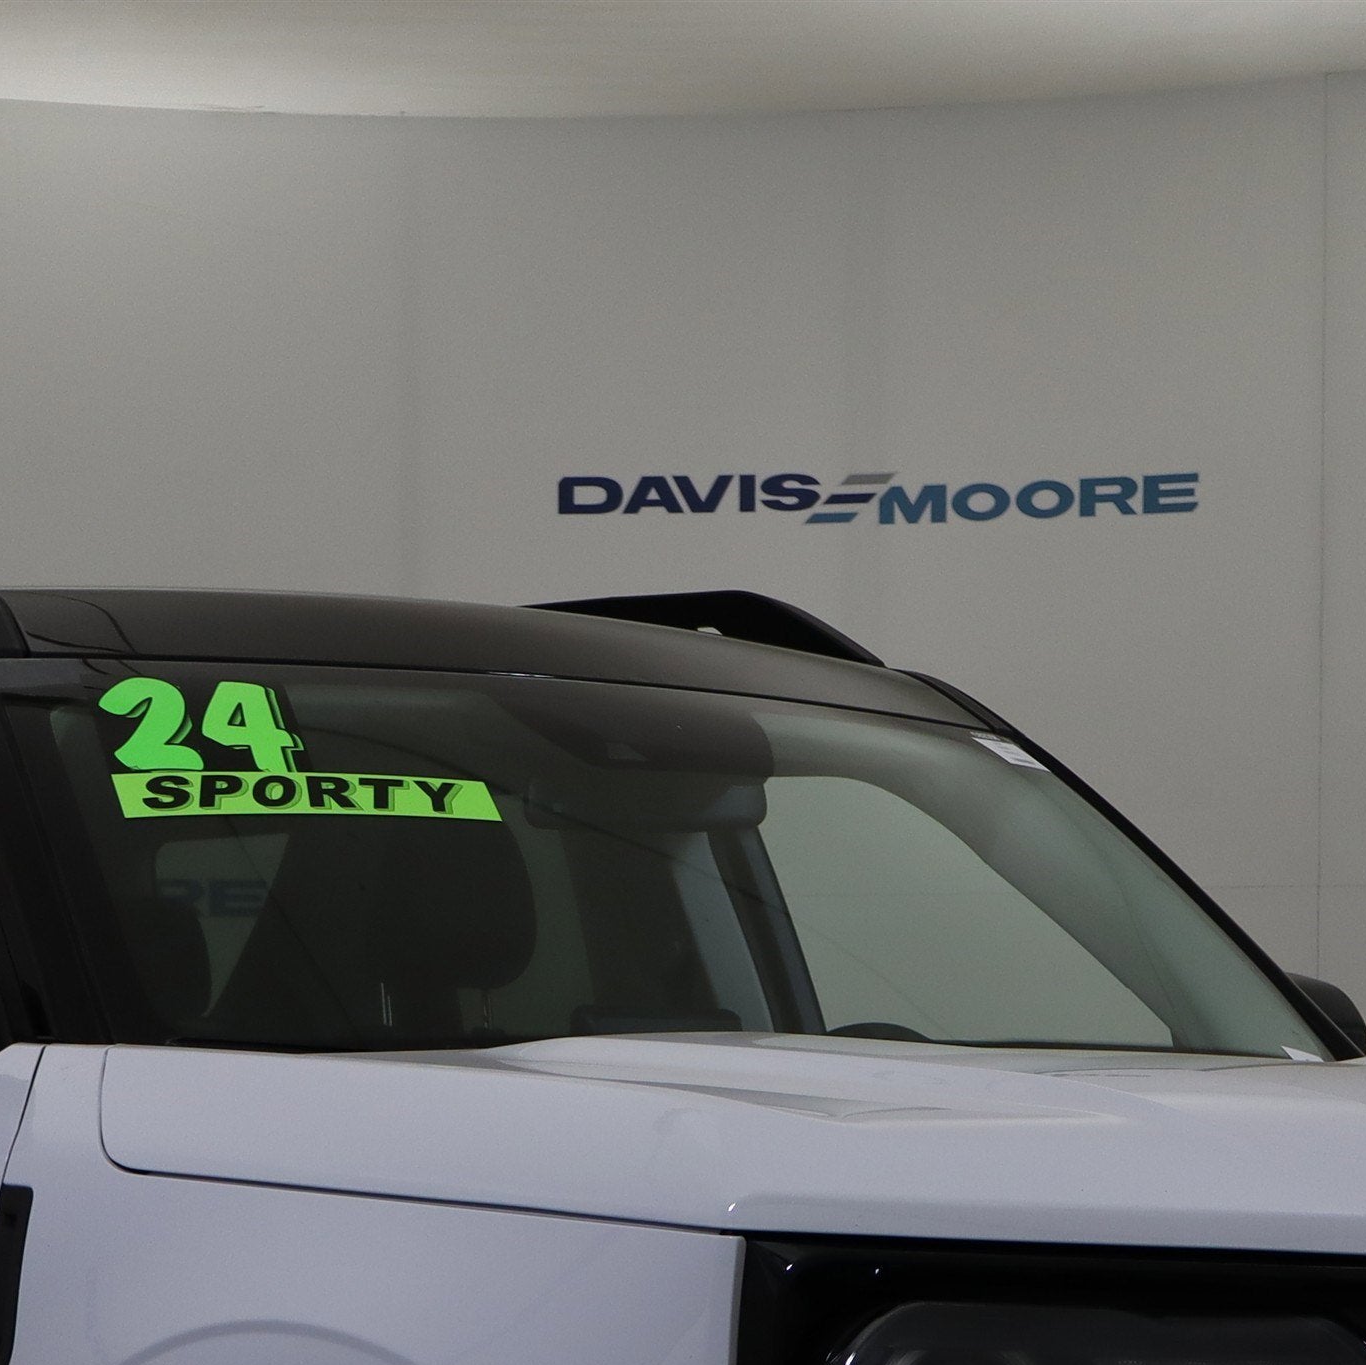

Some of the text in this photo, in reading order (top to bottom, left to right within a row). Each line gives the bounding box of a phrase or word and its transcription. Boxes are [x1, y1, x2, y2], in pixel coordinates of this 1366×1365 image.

[557, 472, 1200, 525] DAVIS MOORE
[97, 676, 306, 772] 24
[141, 775, 463, 812] SPORTY
